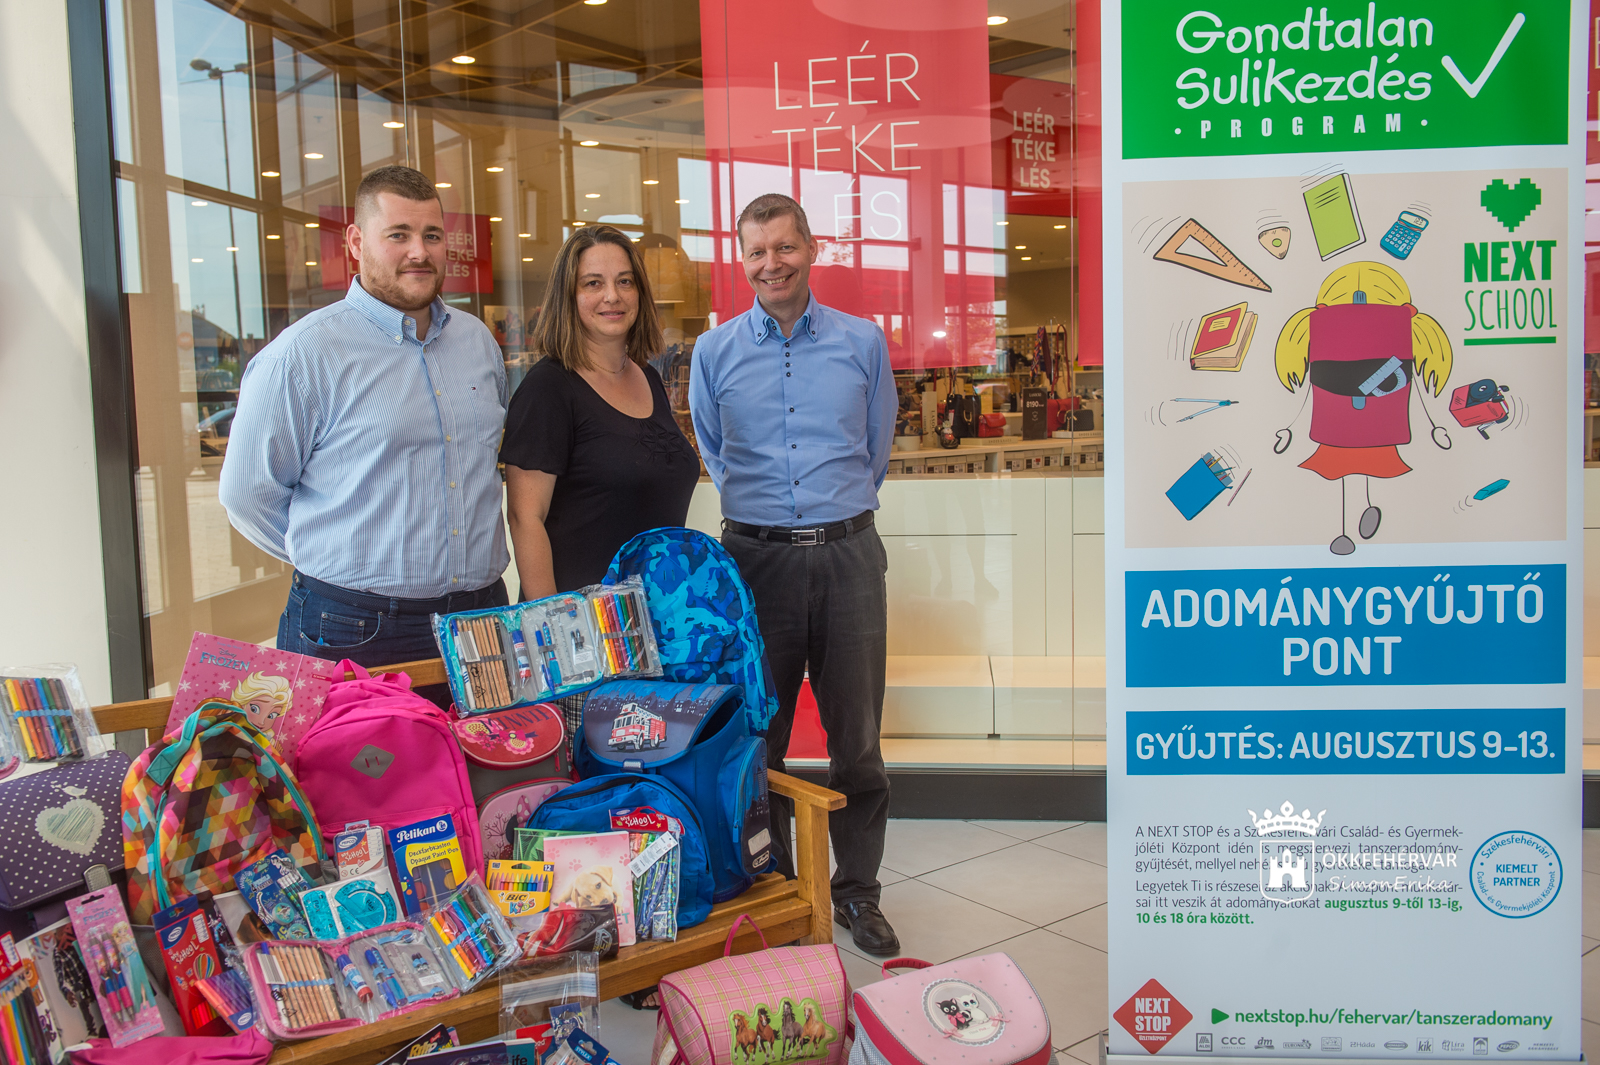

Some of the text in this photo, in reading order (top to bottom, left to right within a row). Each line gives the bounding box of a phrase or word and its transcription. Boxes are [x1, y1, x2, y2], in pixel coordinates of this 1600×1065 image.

[1176, 3, 1433, 54] Gondtalan
[774, 40, 921, 110] LEÉR
[1176, 54, 1432, 109] Sulikezdés
[1013, 107, 1055, 136] LEÉR
[1201, 113, 1401, 139] PROGRAM
[772, 111, 921, 177] TÉKE
[1012, 134, 1056, 163] TÉKE
[1020, 163, 1051, 189] LÉS
[446, 229, 473, 245] EÉR
[447, 244, 475, 261] ÉKE
[1464, 240, 1557, 283] NEXT
[1464, 288, 1557, 331] SCHOOL
[1141, 572, 1544, 628] ADOMÁNYGYŰJTŐ
[199, 652, 250, 672] FROZEN
[1283, 636, 1402, 676] PONT
[1136, 724, 1283, 760] GYŰJTÉS:
[1289, 731, 1476, 759] AUGUSZTUS
[625, 815, 656, 827] SCHOOL
[396, 826, 436, 843] Pelikan
[1135, 826, 1144, 837] A
[1148, 826, 1179, 837] NEXT
[1183, 826, 1213, 837] STOP
[1217, 826, 1230, 837] és
[1233, 828, 1240, 837] a
[1340, 826, 1384, 837] Család-
[1388, 826, 1401, 837] és
[1404, 826, 1463, 840] Gyermek-
[345, 847, 369, 861] SCHOOL
[410, 846, 459, 865] Opaque Paint Box
[1135, 842, 1164, 856] jóléti
[1172, 842, 1220, 856] Központ
[1228, 842, 1254, 854] idén
[1261, 842, 1270, 854] is
[1481, 834, 1552, 859] Székesfehérvári
[1135, 858, 1192, 873] gyűjtését,
[1195, 858, 1236, 872] mellyel
[1496, 864, 1538, 873] KIEMELT
[1136, 880, 1188, 894] Legyetek
[1191, 880, 1201, 891] Ti
[1205, 880, 1213, 892] is
[1493, 877, 1541, 886] PARTNER
[1136, 897, 1151, 908] sai
[1155, 897, 1168, 908] itt
[1172, 897, 1206, 908] veszik
[1210, 897, 1222, 908] át
[1324, 898, 1388, 912] augusztus
[1392, 897, 1423, 909] 9-től
[1428, 897, 1463, 912] 13-ig,
[83, 906, 117, 925] FROZEN
[1136, 912, 1254, 924] 10 és 18 óra között.
[1135, 997, 1171, 1013] NEXT
[1135, 1015, 1171, 1032] STOP
[1235, 1008, 1553, 1030] nextstop.hu/fehervar/tanszeradomany
[1221, 1036, 1246, 1045] CCC
[1257, 1037, 1273, 1046] dm
